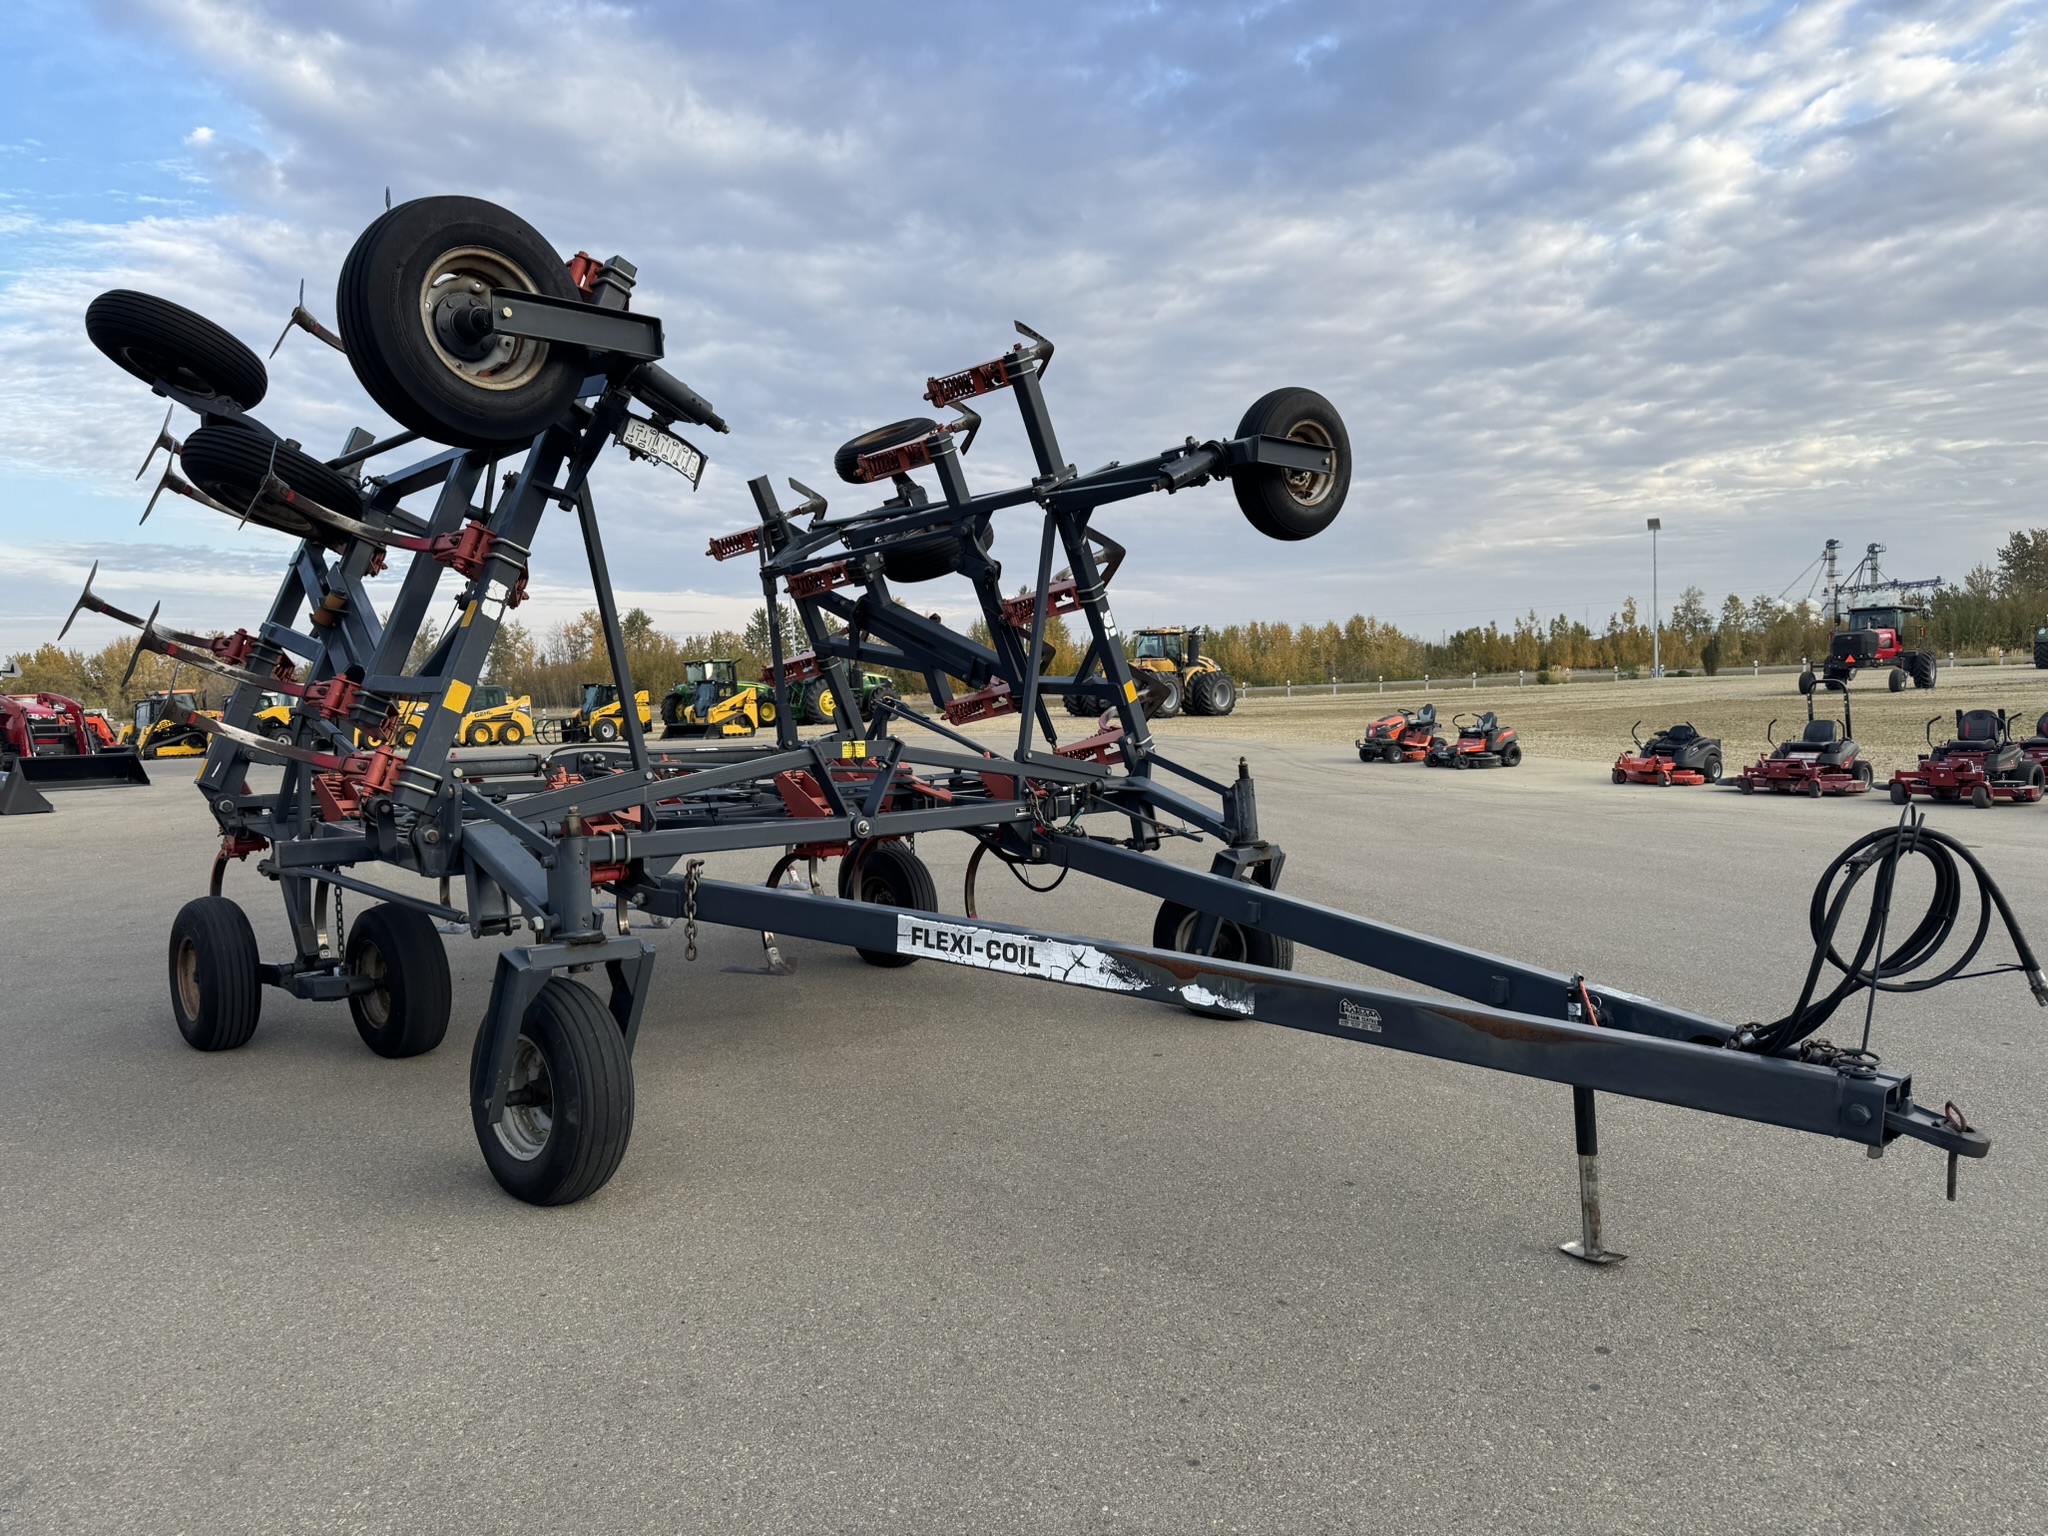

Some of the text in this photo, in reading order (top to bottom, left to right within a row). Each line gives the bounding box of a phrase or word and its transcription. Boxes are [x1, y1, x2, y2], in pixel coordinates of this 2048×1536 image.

[649, 428, 658, 436] 9
[625, 433, 634, 444] 12
[638, 439, 647, 449] 10
[672, 441, 680, 449] 5
[650, 447, 658, 455] 8
[682, 446, 689, 454] 3
[661, 453, 669, 461] 6
[681, 465, 688, 473] 2
[911, 926, 1041, 968] FLEXI-COIL
